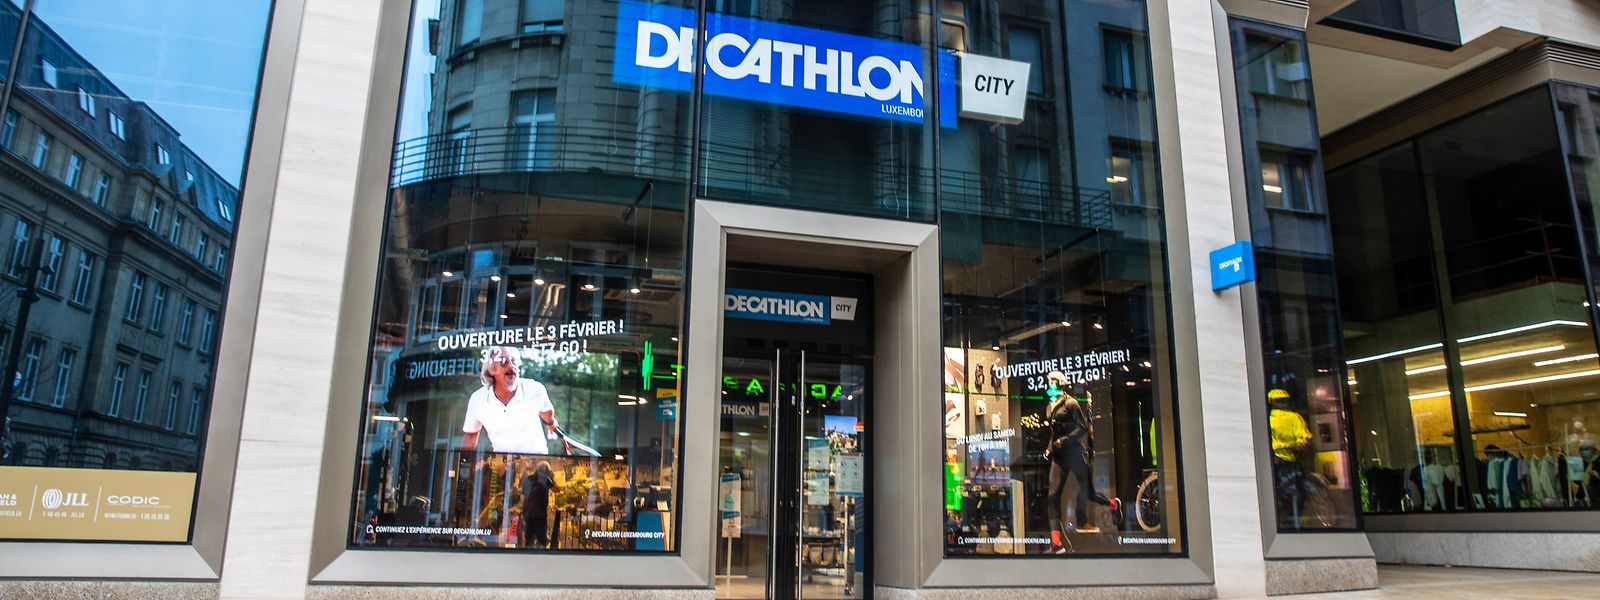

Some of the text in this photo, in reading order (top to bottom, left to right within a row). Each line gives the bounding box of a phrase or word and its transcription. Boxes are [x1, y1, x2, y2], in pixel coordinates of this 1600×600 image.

[635, 20, 924, 104] DECATHLON
[974, 74, 1016, 96] CITY
[724, 294, 824, 318] DECATHLON
[836, 304, 852, 313] CITY
[438, 319, 625, 350] OUVERTURE LE 3 FÉVRIER !
[480, 345, 507, 364] 3,2,
[559, 340, 580, 357] GO
[995, 348, 1131, 379] OUVERTURE LE 3 FÉVRIER !
[1027, 375, 1050, 391] 3,2,
[1085, 367, 1100, 382] GO
[1101, 366, 1106, 379] !
[720, 404, 755, 416] THLON
[62, 492, 90, 506] JLL
[107, 495, 160, 505] CODIC
[375, 525, 405, 534] CONTINUEZ
[442, 527, 453, 535] SUR
[591, 530, 665, 539] DECATHLON LUXEMBOURG CITY
